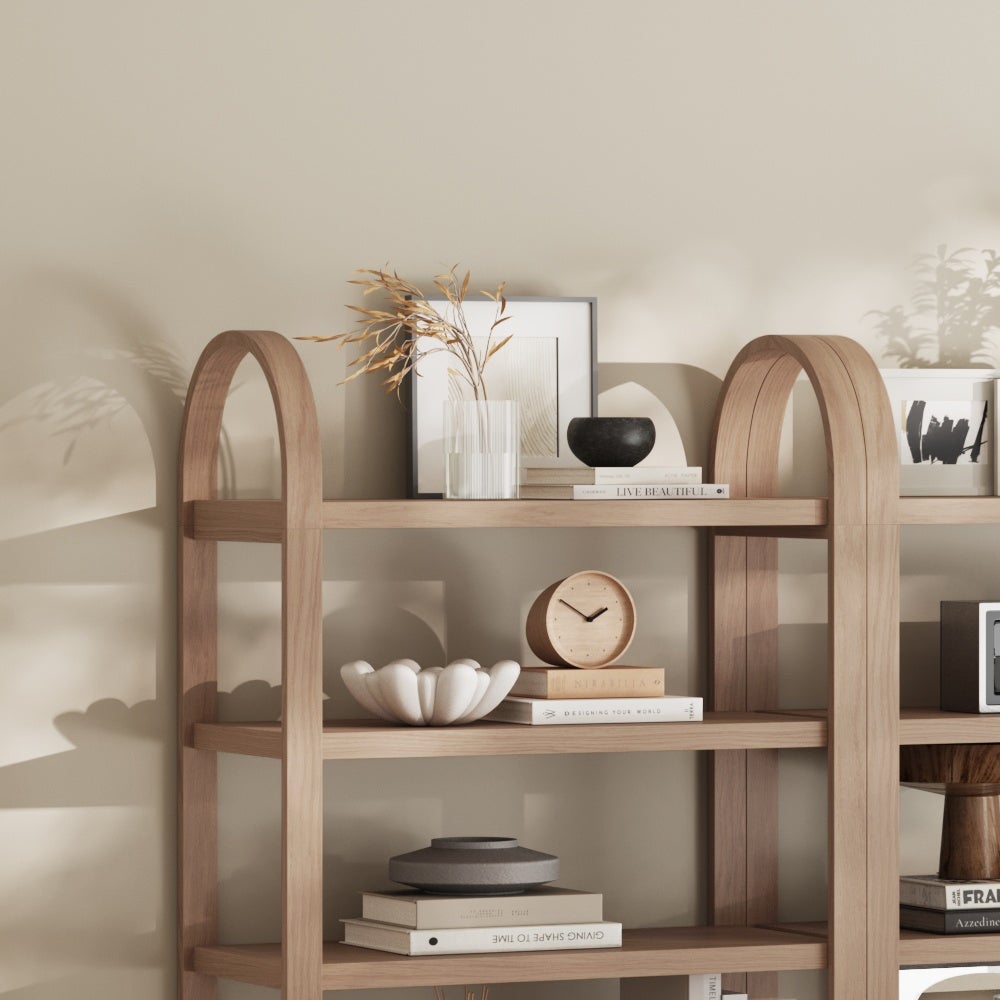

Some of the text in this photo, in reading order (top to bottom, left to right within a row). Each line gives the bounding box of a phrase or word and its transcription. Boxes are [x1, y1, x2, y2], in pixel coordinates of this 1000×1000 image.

[617, 487, 642, 497] LIVE
[645, 486, 707, 497] BEAUTIFUL
[955, 914, 1000, 928] Azzedine
[491, 930, 605, 944] GIVING SHAPE TO TIME
